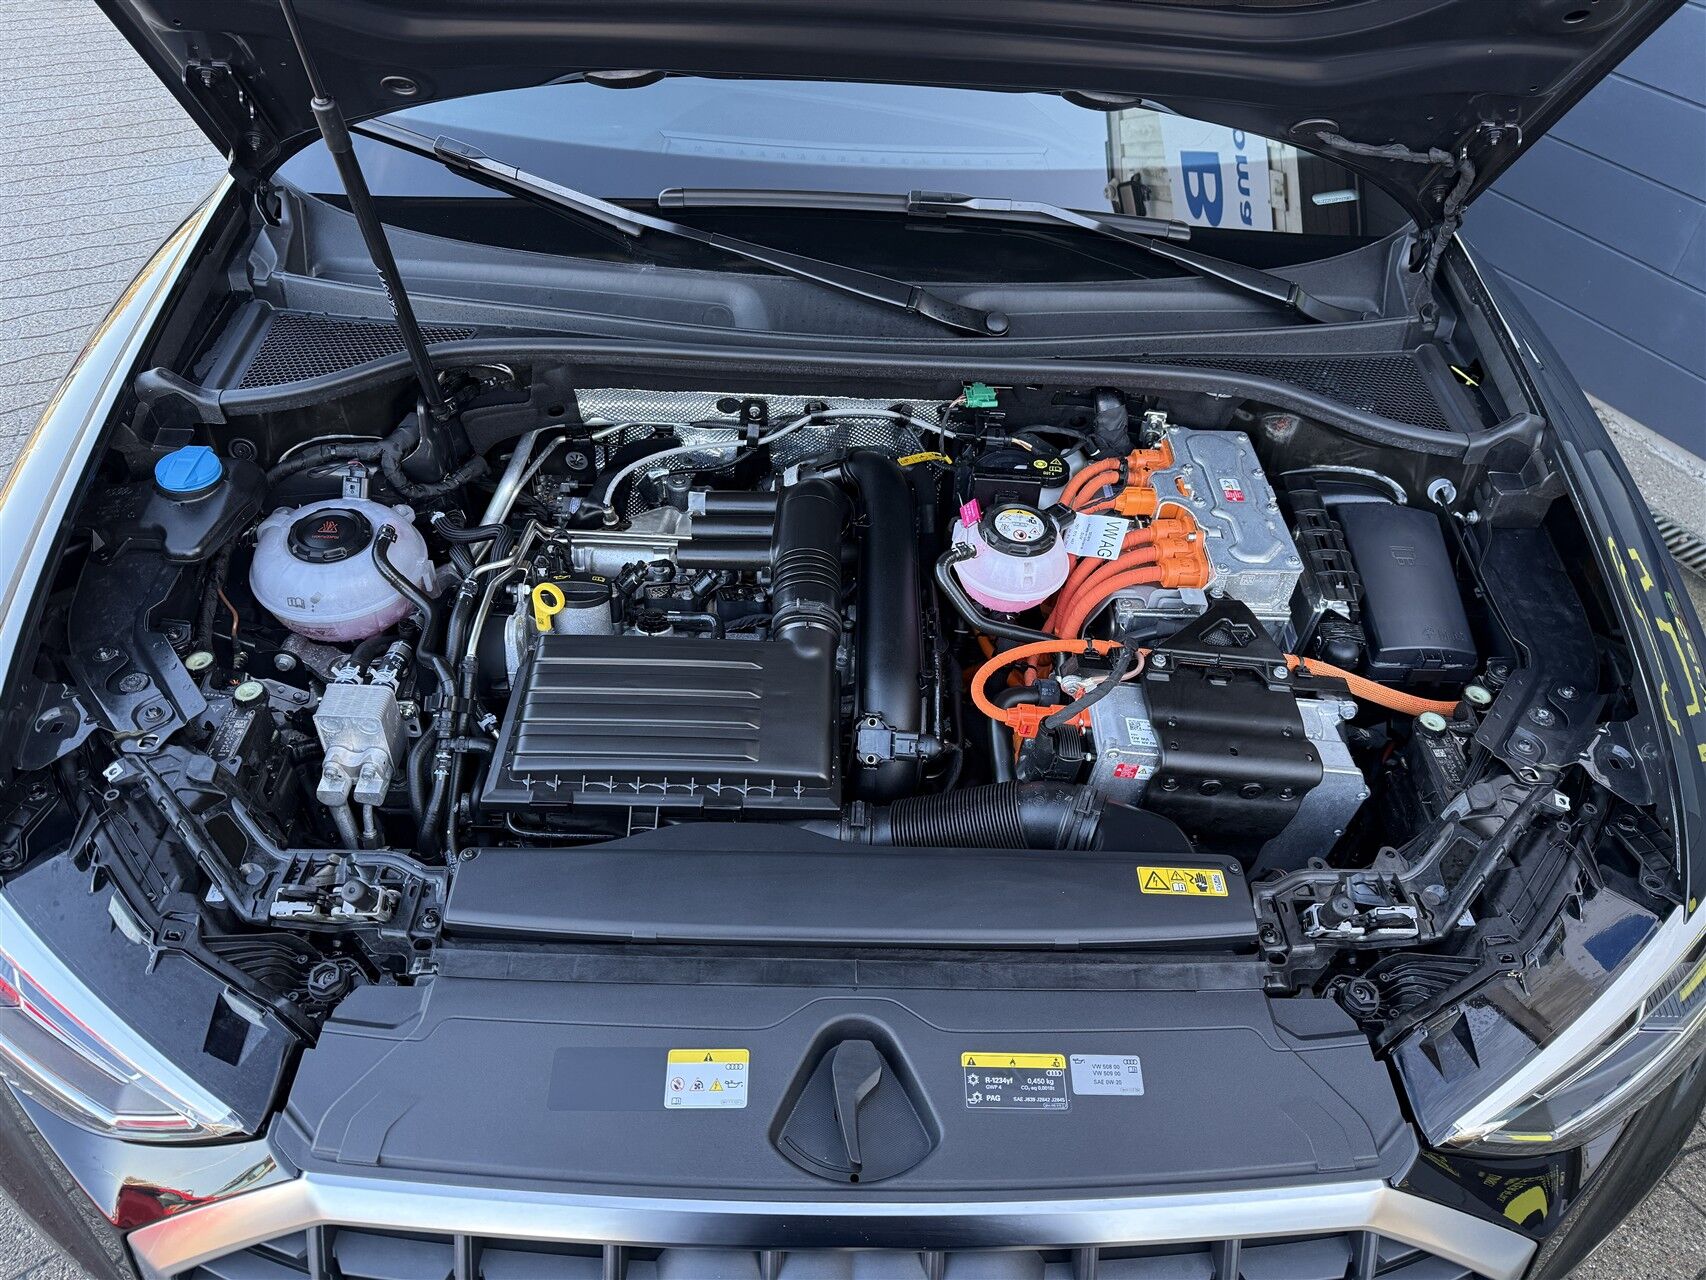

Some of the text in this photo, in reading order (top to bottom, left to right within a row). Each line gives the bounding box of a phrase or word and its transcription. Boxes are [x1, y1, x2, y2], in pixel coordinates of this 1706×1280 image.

[1097, 521, 1122, 557] VW AG
[985, 1076, 1013, 1085] R-1234yf
